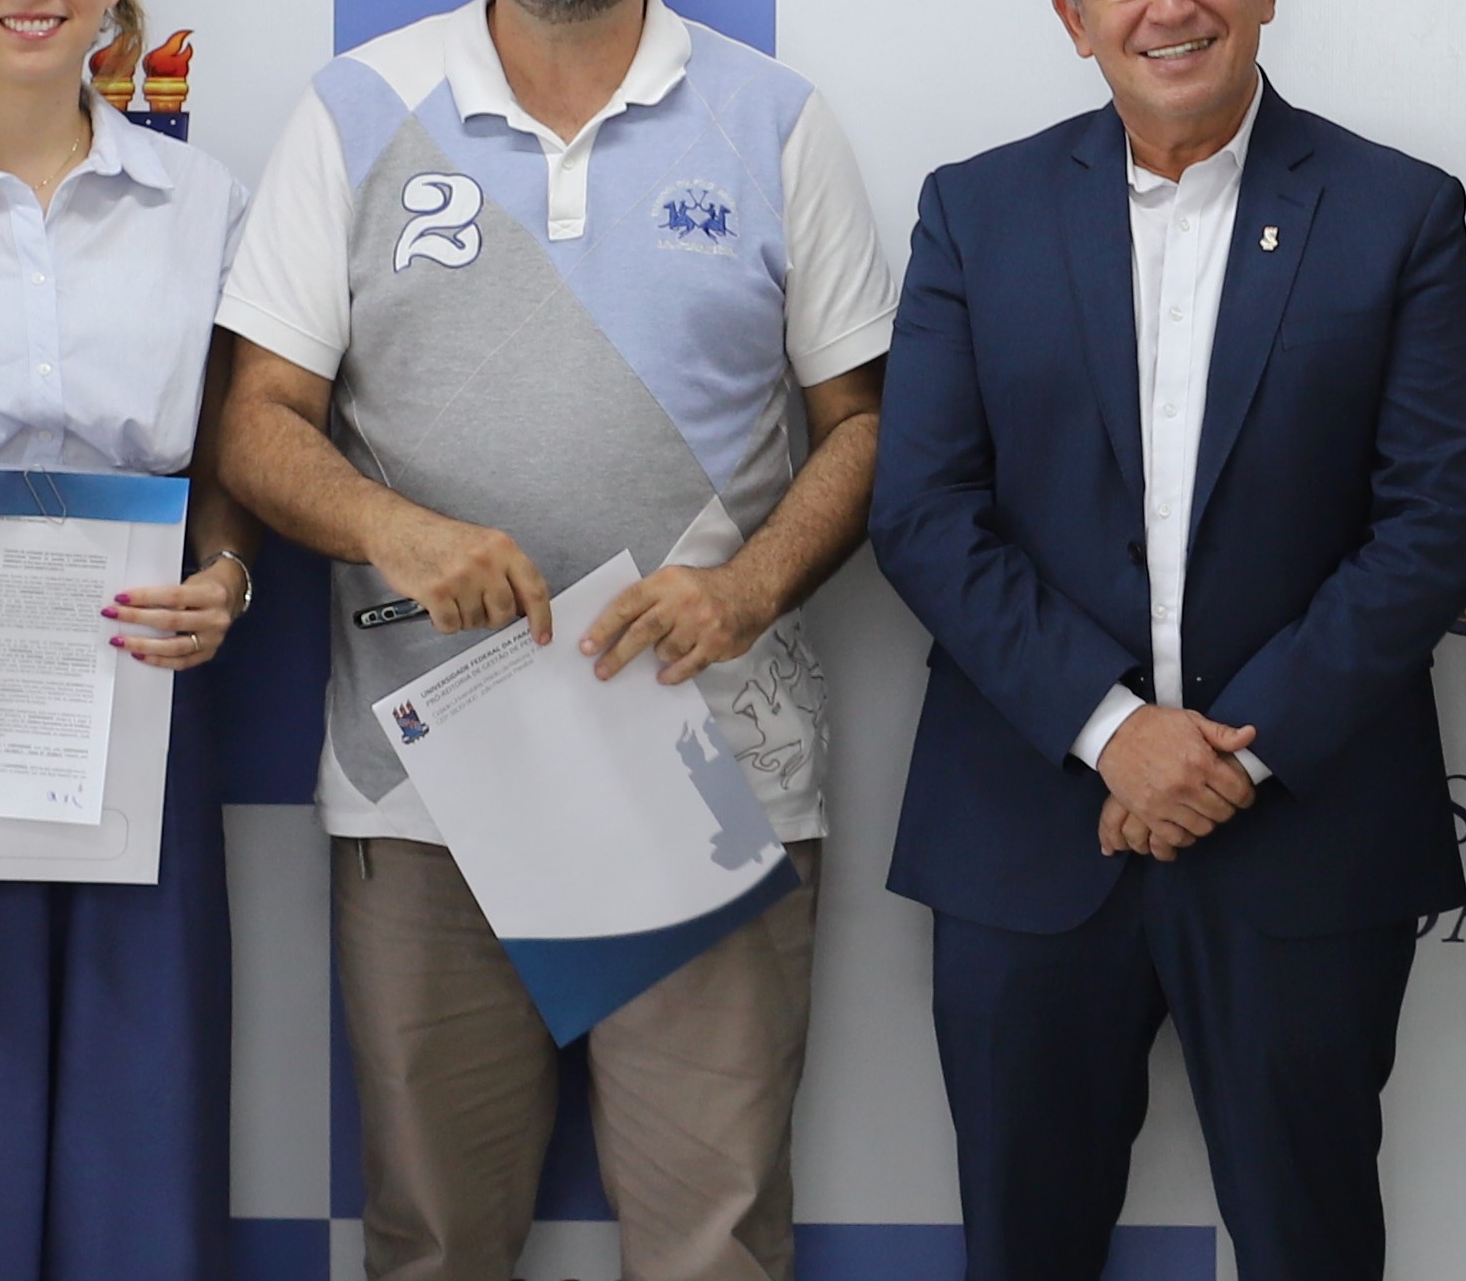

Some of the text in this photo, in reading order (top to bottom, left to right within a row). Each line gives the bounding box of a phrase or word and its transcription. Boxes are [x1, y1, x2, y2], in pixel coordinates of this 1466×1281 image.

[394, 172, 483, 272] 2
[420, 664, 470, 698] UNIVERSIDADE
[470, 647, 500, 668] FEDERAL
